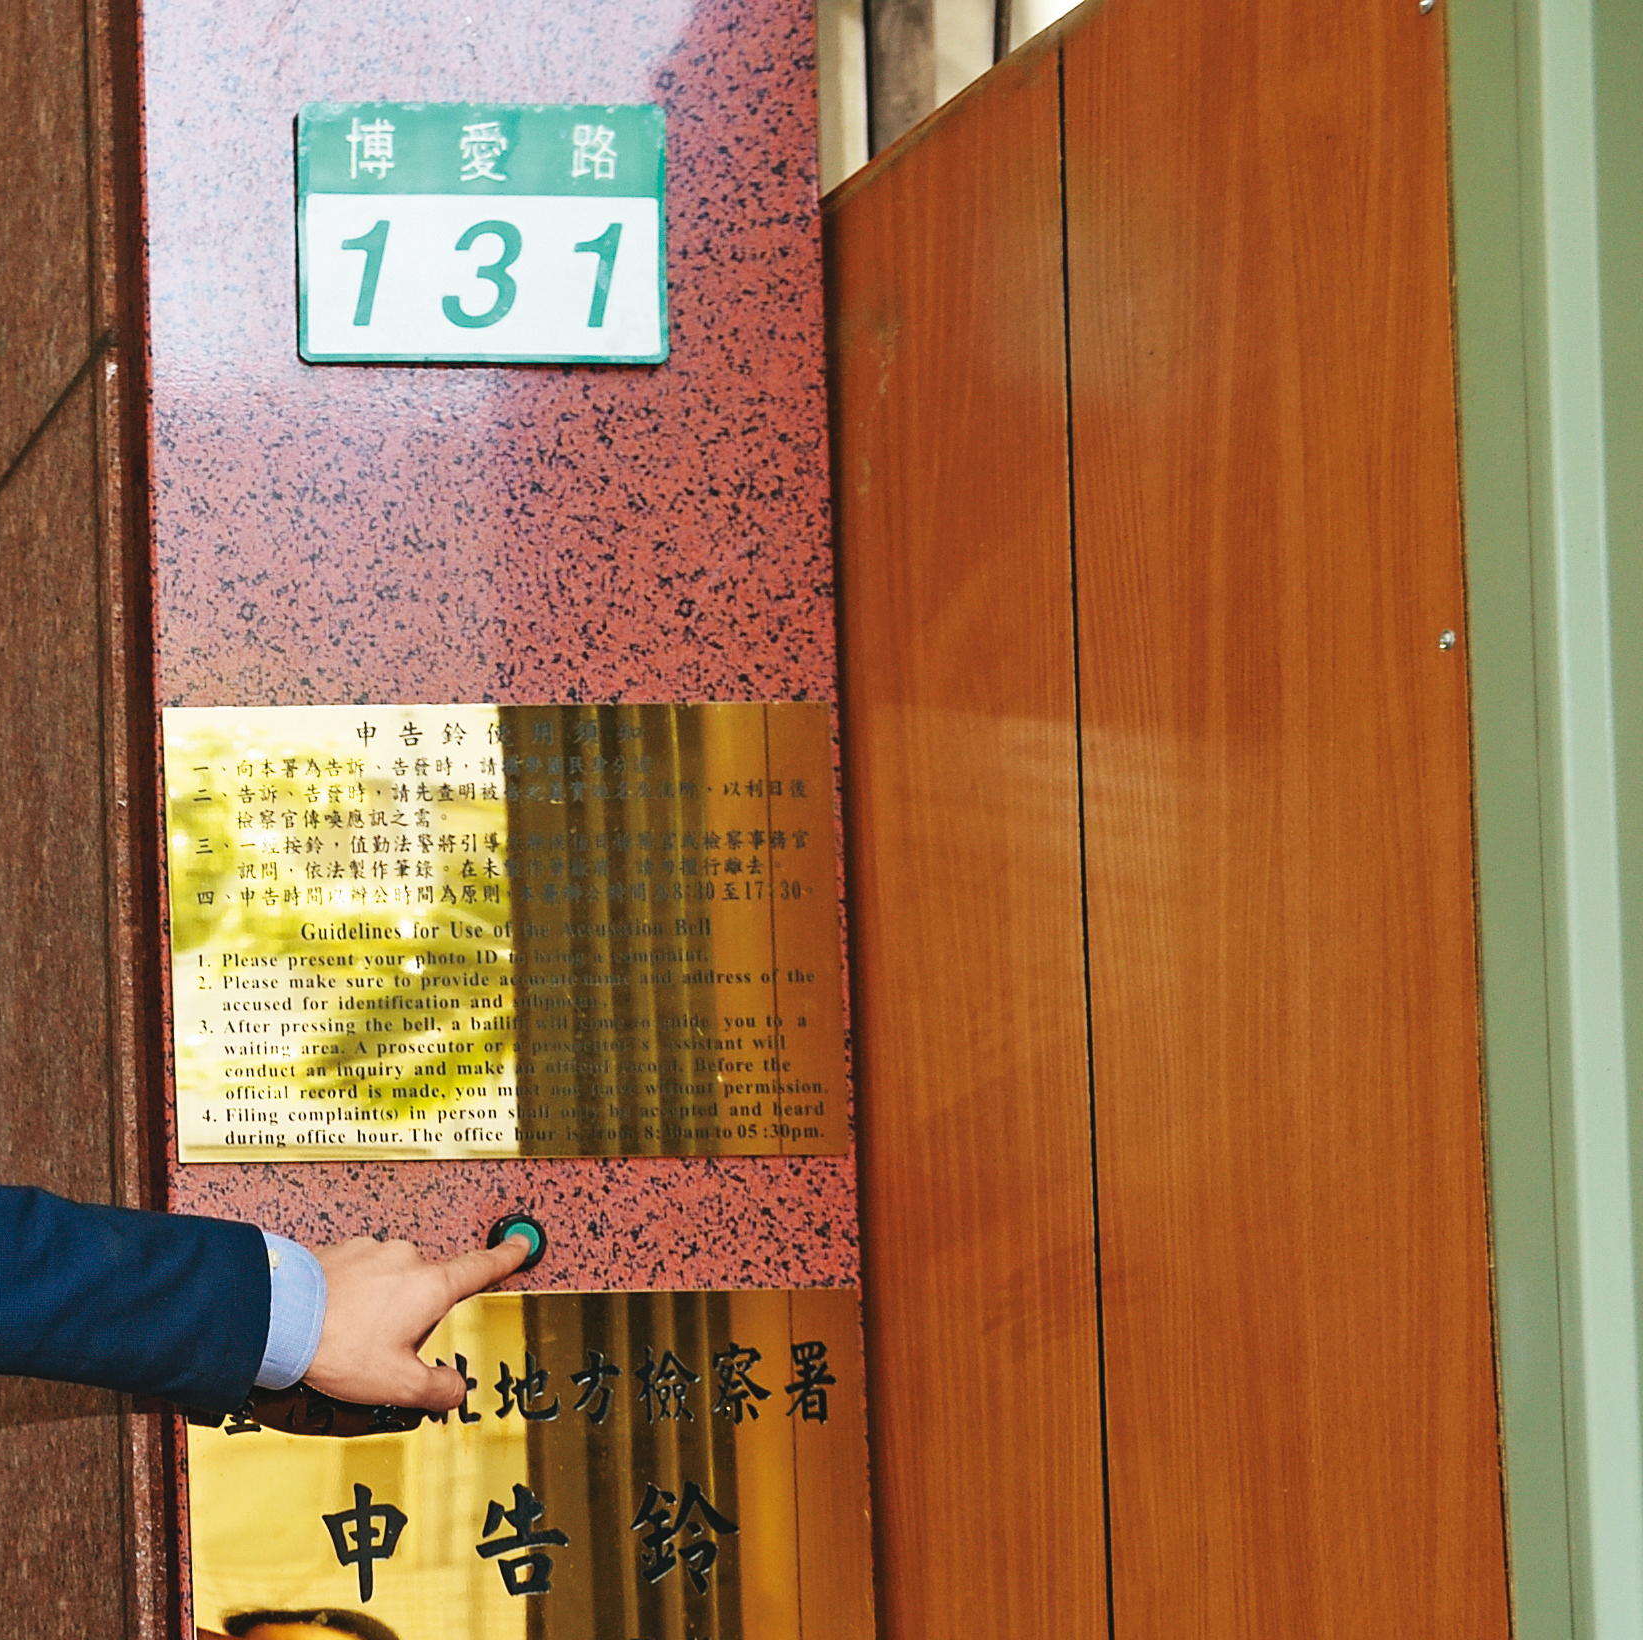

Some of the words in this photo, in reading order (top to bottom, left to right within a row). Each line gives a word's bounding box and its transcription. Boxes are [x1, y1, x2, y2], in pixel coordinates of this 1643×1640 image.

[346, 118, 617, 182] 博愛路
[340, 219, 623, 329] 131
[356, 721, 645, 748] 申告鈴使用須知
[300, 923, 403, 940] Guidelines
[412, 922, 440, 940] for
[450, 922, 484, 938] Use
[493, 922, 513, 938] of
[521, 921, 550, 938] the
[563, 922, 664, 938] Accusation
[674, 919, 712, 936] Bell
[197, 954, 212, 967] 1.
[222, 954, 279, 967] Please
[288, 953, 355, 970] present
[363, 954, 406, 969] your
[414, 952, 466, 968] photo
[476, 951, 499, 964] ID
[508, 950, 527, 963] to
[594, 953, 605, 963] a
[197, 977, 213, 990] 2.
[222, 976, 280, 989] Please
[288, 975, 338, 988] make
[345, 978, 385, 988] sure
[394, 975, 411, 987] to
[420, 972, 490, 990] provide
[638, 971, 673, 984] and
[682, 971, 752, 984] address
[760, 970, 779, 983] of
[787, 969, 816, 983] the
[222, 998, 293, 1011] accused
[302, 997, 330, 1010] for
[337, 995, 461, 1009] identification
[469, 994, 503, 1008] and
[198, 1020, 214, 1034] 3.
[223, 1020, 271, 1033] After
[280, 1019, 357, 1036] pressing
[365, 1018, 394, 1032] the
[402, 1017, 443, 1033] bell,
[450, 1020, 462, 1031] a
[723, 1016, 757, 1031] you
[766, 1015, 784, 1027] to
[797, 1017, 808, 1027] a
[224, 1043, 292, 1058] waiting
[300, 1043, 347, 1055] area.
[354, 1042, 372, 1054] A
[376, 1041, 475, 1057] prosecutor
[483, 1041, 504, 1053] or
[512, 1042, 523, 1052] a
[664, 1036, 744, 1050] assistant
[752, 1035, 787, 1049] will
[224, 1065, 297, 1078] conduct
[305, 1065, 327, 1077] an
[337, 1064, 404, 1080] inquiry
[413, 1063, 447, 1076] and
[457, 1062, 506, 1075] make
[515, 1064, 536, 1075] an
[694, 1059, 754, 1073] Before
[762, 1058, 792, 1072] the
[224, 1086, 290, 1100] official
[299, 1085, 359, 1099] record
[367, 1085, 383, 1098] is
[391, 1084, 447, 1099] made,
[455, 1085, 488, 1100] you
[497, 1083, 541, 1096] must
[644, 1081, 715, 1095] without
[723, 1080, 830, 1098] permission.
[201, 1109, 218, 1122] 4.
[225, 1108, 279, 1124] Filing
[287, 1108, 400, 1124] complaint(s)
[409, 1107, 427, 1120] in
[437, 1108, 499, 1123] person
[507, 1103, 550, 1119] shall
[639, 1102, 719, 1119] accepted
[729, 1102, 763, 1116] and
[772, 1101, 826, 1116] heard
[224, 1132, 287, 1147] during
[296, 1130, 347, 1143] office
[356, 1129, 404, 1143] hour.
[409, 1129, 444, 1142] The
[453, 1128, 504, 1141] office
[514, 1128, 556, 1141] hour
[565, 1126, 578, 1140] is
[715, 1126, 733, 1139] to
[322, 1480, 741, 1603] 申告鈴
